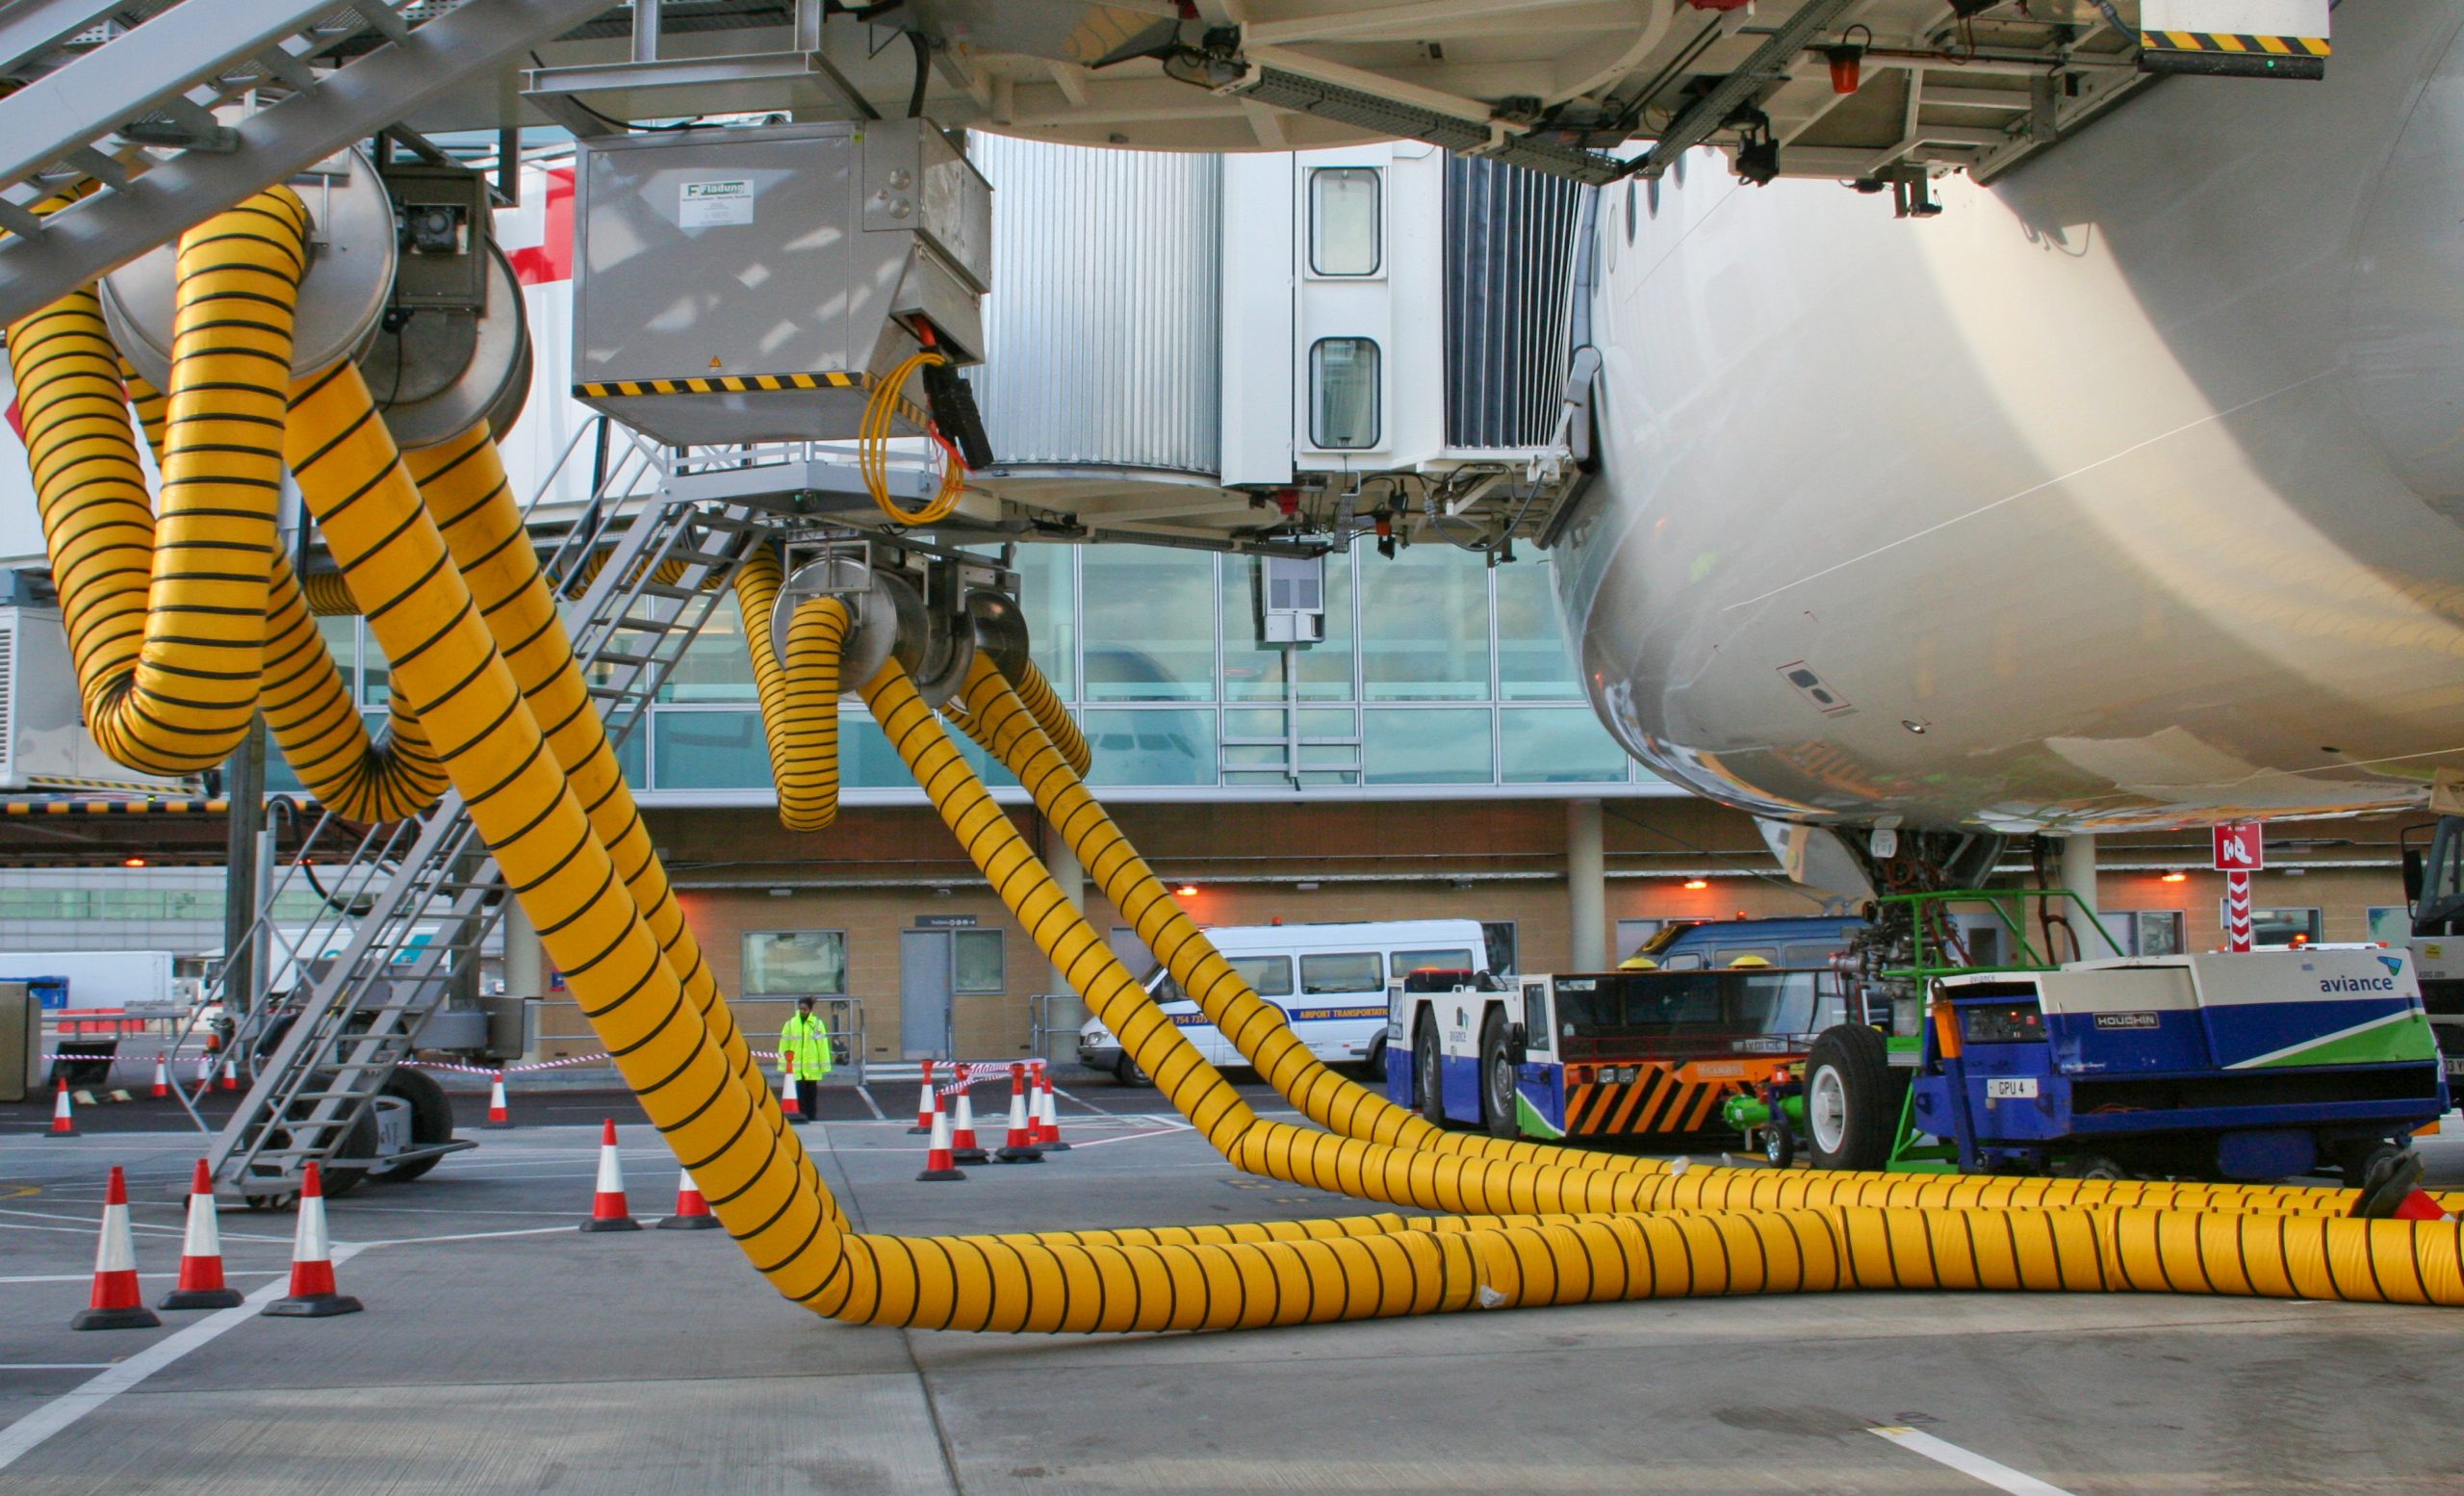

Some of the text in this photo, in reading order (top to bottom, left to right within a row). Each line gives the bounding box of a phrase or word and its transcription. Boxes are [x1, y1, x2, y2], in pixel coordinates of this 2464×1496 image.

[2320, 975, 2394, 993] aviance
[1299, 1009, 1330, 1019] AIRPORT
[2097, 1016, 2155, 1025] HOUCHIN
[1999, 1081, 2024, 1095] GPU 4
